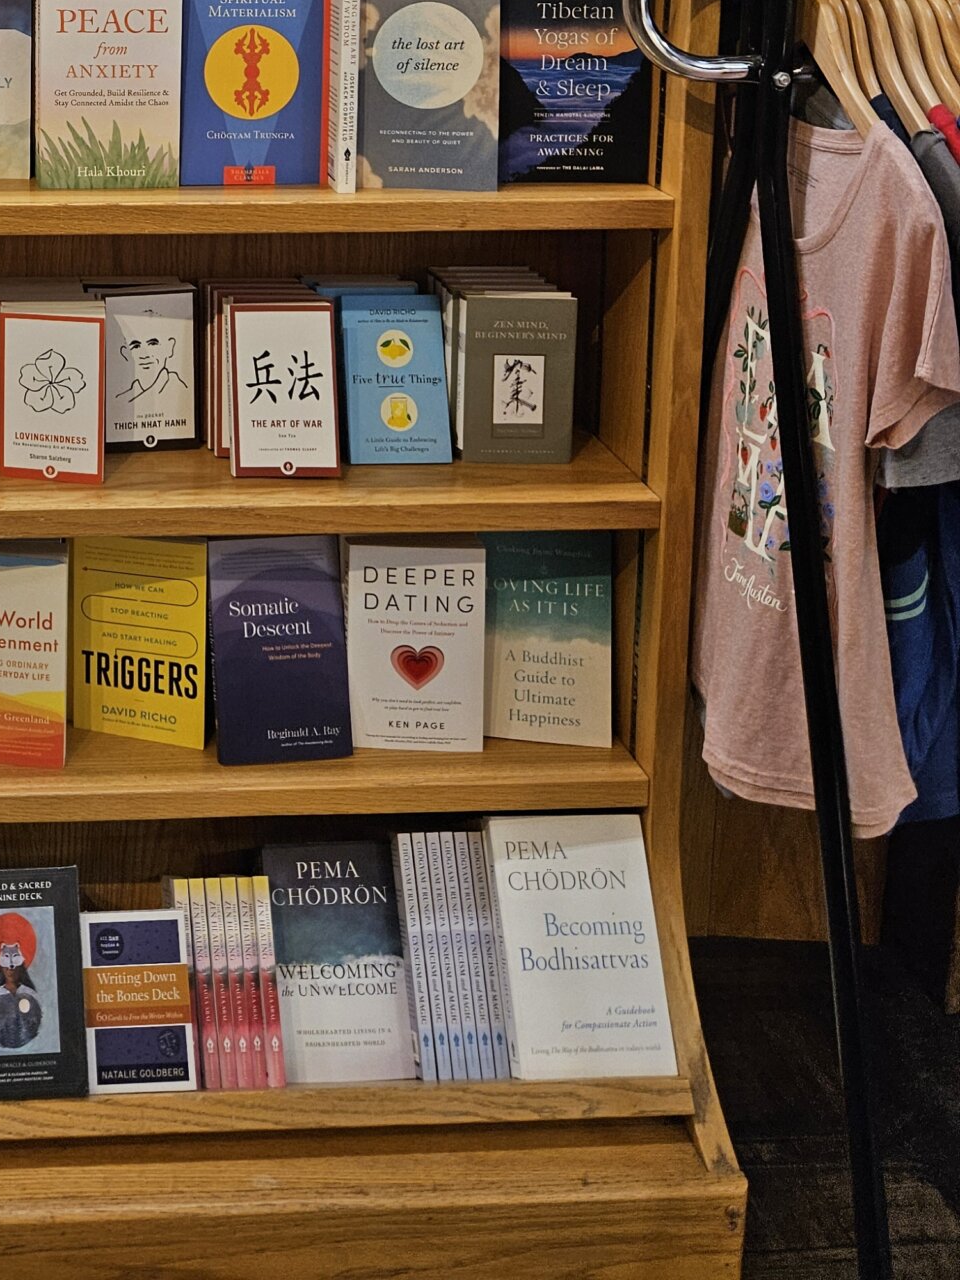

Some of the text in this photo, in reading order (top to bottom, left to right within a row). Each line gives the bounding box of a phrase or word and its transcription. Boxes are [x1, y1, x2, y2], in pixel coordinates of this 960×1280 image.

[537, 3, 613, 19] Tibetan
[56, 9, 168, 33] PEACE
[94, 42, 128, 58] from
[392, 38, 465, 50] the lost art
[66, 65, 159, 78] ANXIETY
[396, 59, 459, 73] of silence
[541, 55, 607, 70] Dream
[557, 80, 610, 100] Sleep
[246, 350, 323, 404] 兵法
[251, 420, 322, 428] THE ART OF WAR
[15, 432, 87, 445] LOVINGKINDNESS
[363, 566, 475, 586] DEEPER
[741, 574, 788, 611] Austen
[229, 599, 299, 617] Somatic
[364, 593, 475, 613] DATING
[243, 620, 311, 638] Descent
[522, 649, 584, 667] Buddhist
[514, 689, 576, 706] Ultimate
[416, 721, 445, 729] PAGE
[509, 709, 581, 727] Happiness
[296, 861, 360, 880] PEMA
[272, 884, 388, 906] CHÖDRÖN
[544, 912, 645, 944] Becoming
[520, 946, 649, 972] Bodhisattvas
[97, 972, 176, 987] Writing Down
[102, 1068, 184, 1080] NATALIE GOLDBERG
